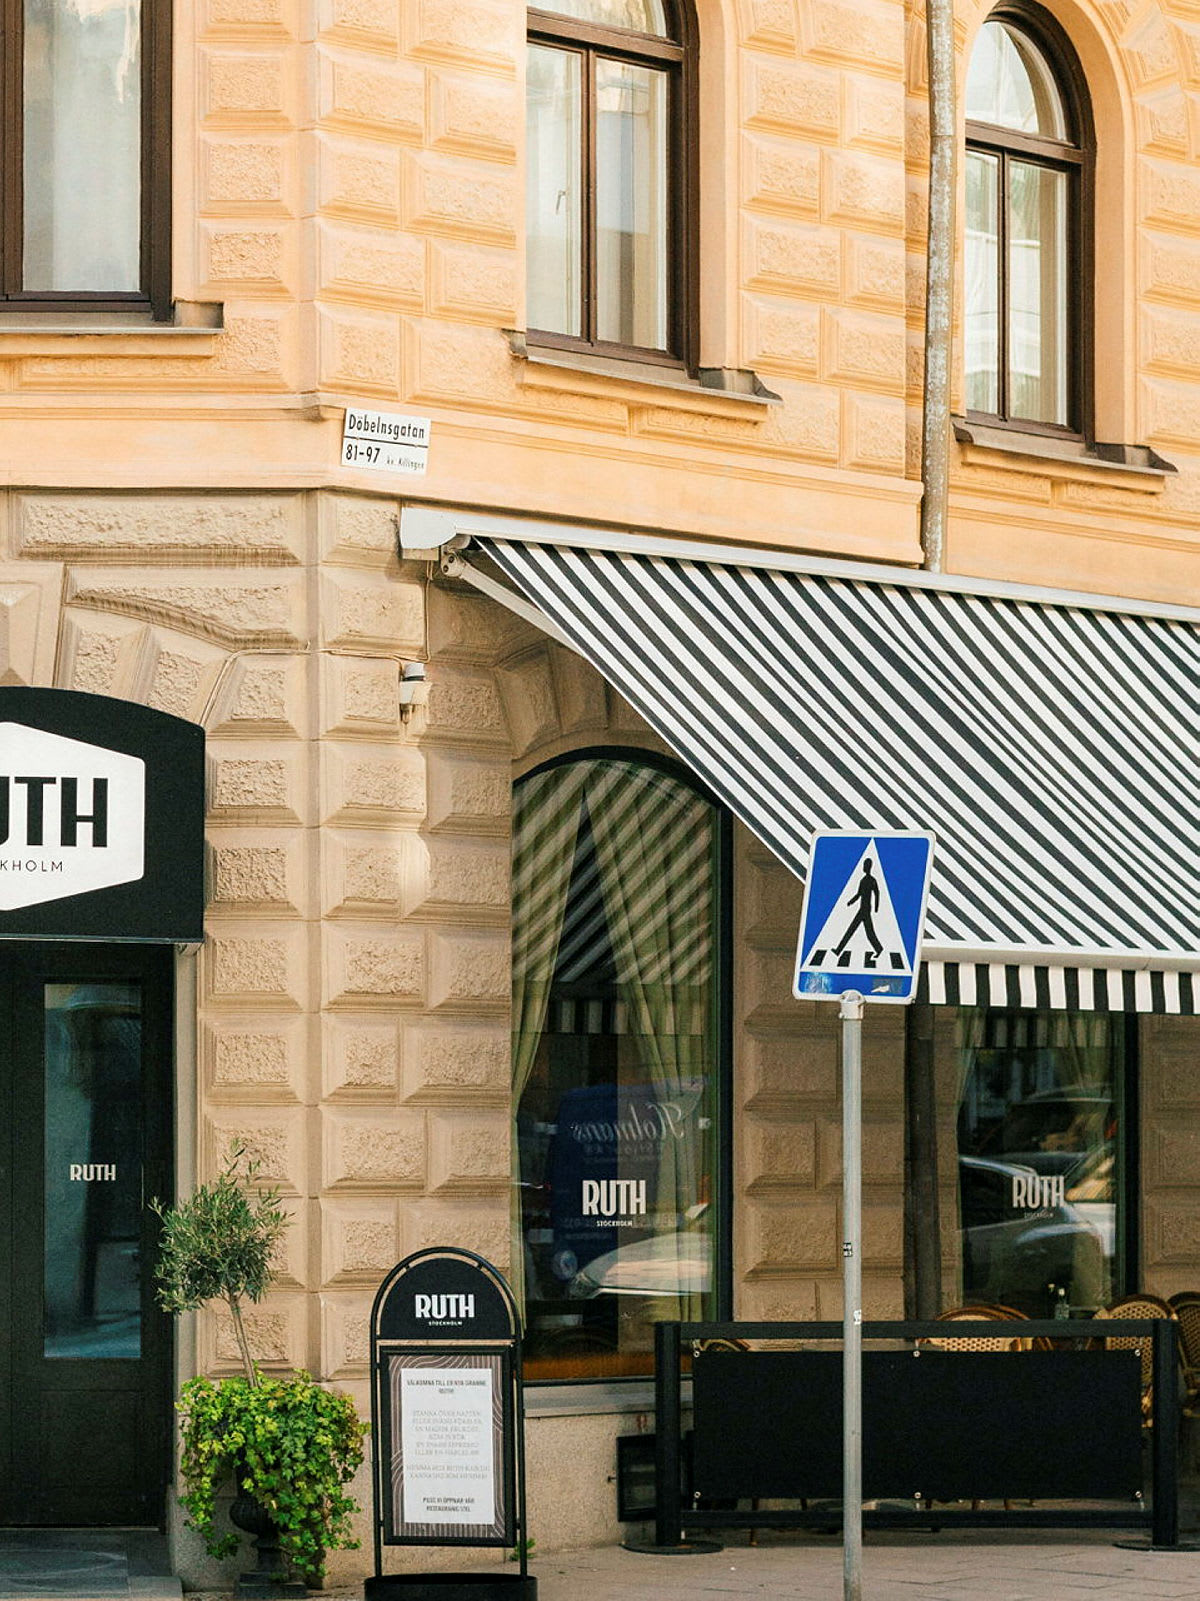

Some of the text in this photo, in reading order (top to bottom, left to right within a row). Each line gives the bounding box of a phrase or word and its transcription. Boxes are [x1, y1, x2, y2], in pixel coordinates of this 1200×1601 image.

[348, 413, 425, 440] Döbelnsgatan
[345, 443, 381, 464] 81-97
[69, 1163, 117, 1182] RUTH
[582, 1179, 647, 1217] RUTH
[1012, 1174, 1065, 1209] RUTH
[414, 1293, 476, 1319] RUTH
